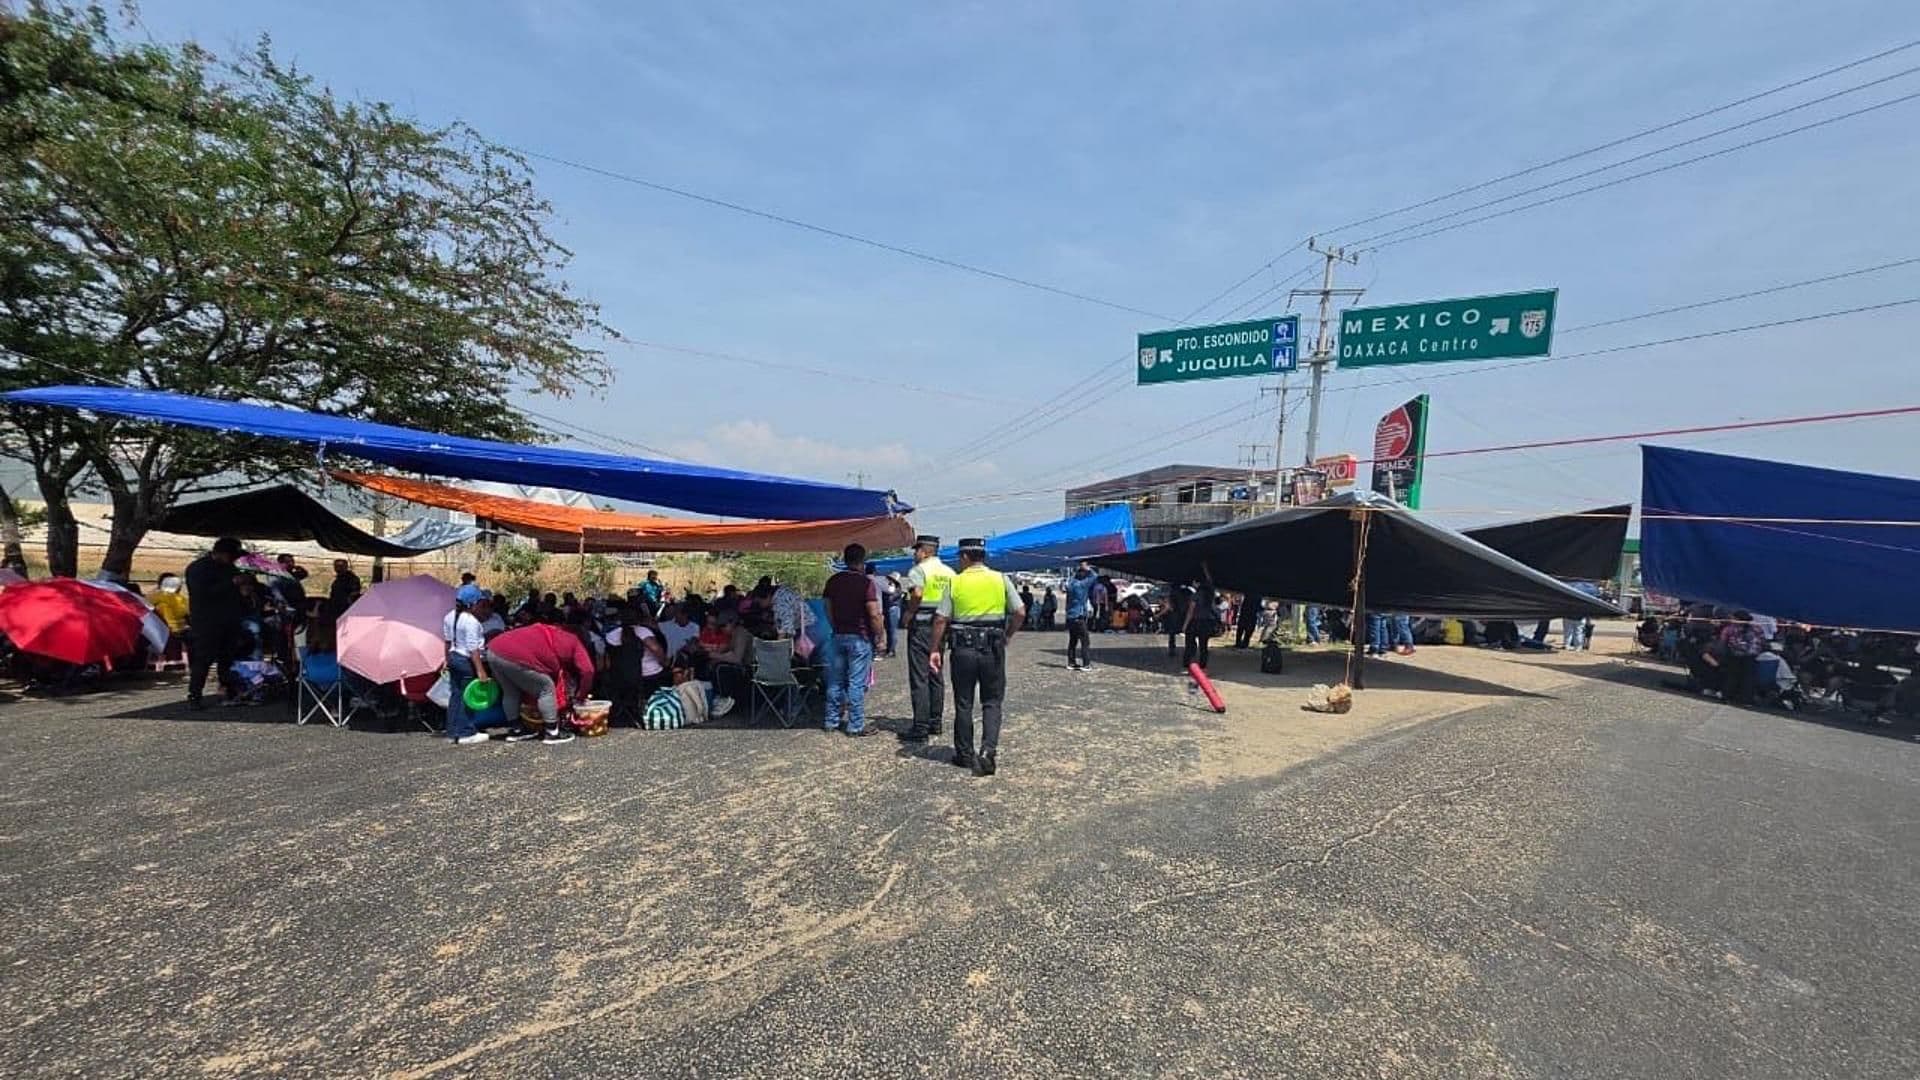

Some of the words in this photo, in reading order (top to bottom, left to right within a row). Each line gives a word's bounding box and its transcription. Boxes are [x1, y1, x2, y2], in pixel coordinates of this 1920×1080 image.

[1345, 308, 1481, 334] MEXICO
[1525, 320, 1541, 333] 175
[1176, 337, 1201, 351] PTO.
[1203, 329, 1269, 349] ESCONDIDO
[1343, 339, 1409, 358] OAXACA
[1419, 337, 1479, 353] Centro
[1176, 353, 1267, 373] JUQUILA
[1375, 458, 1414, 472] PEMEX
